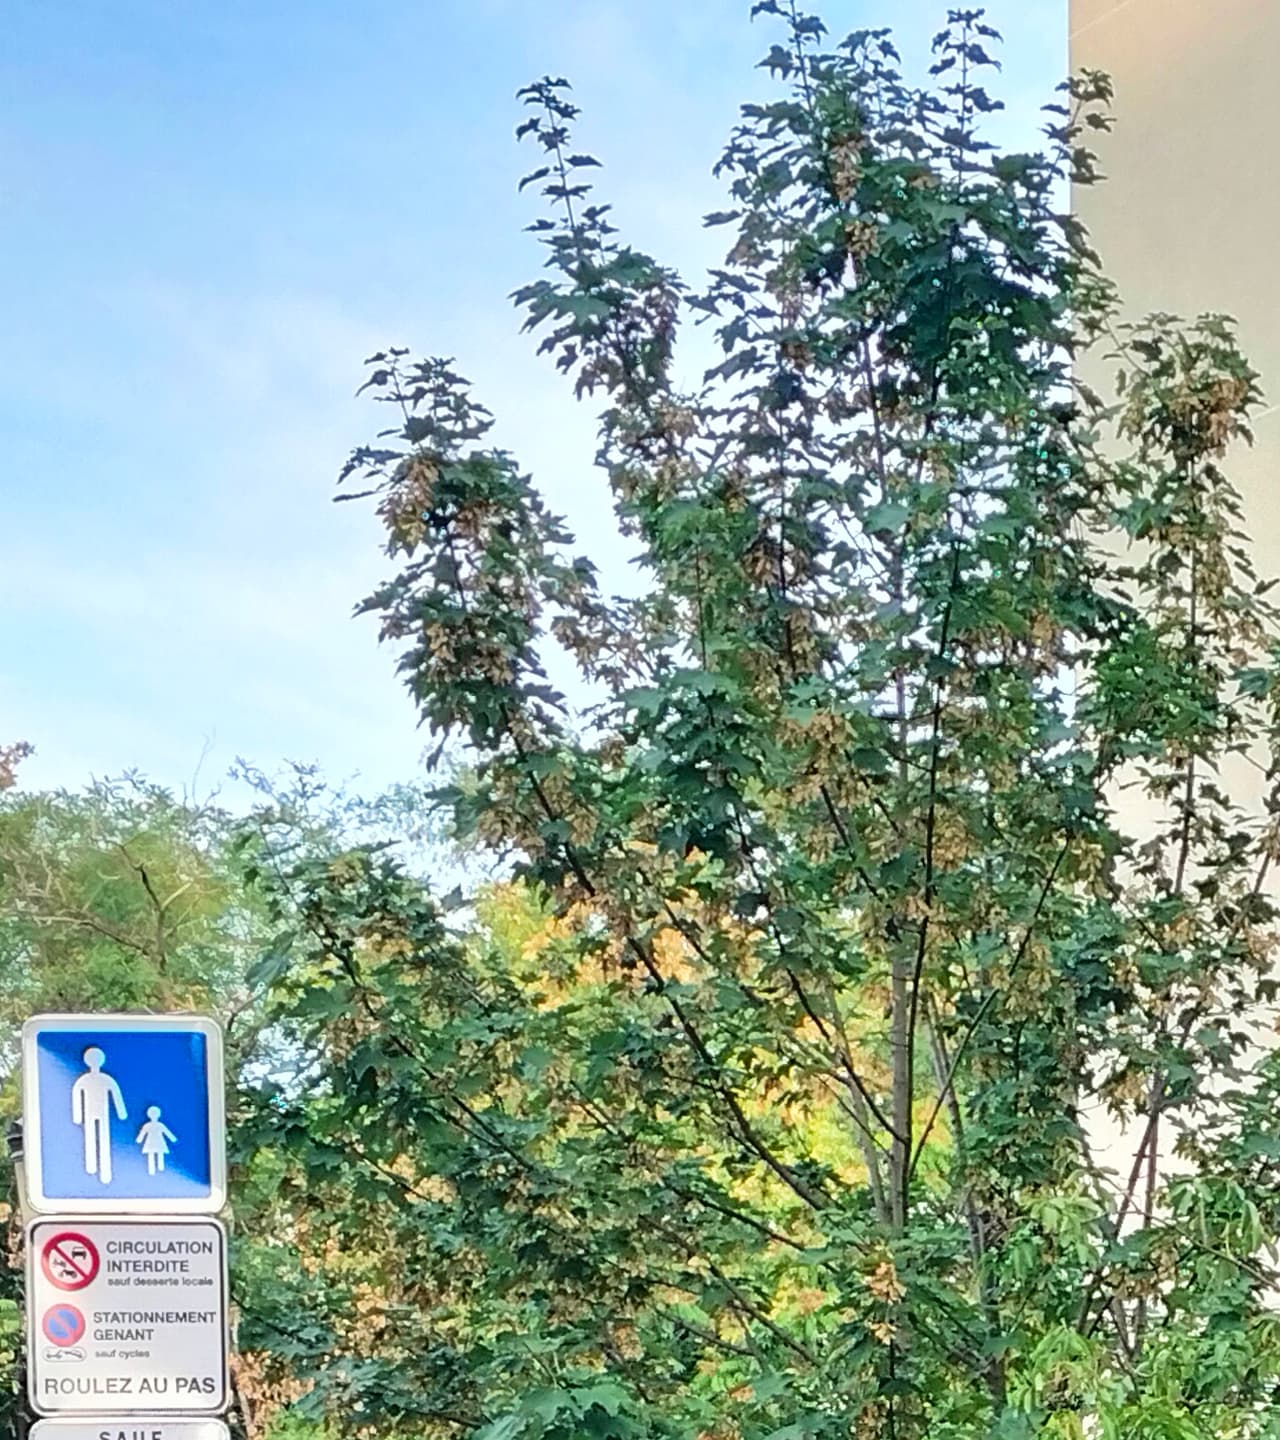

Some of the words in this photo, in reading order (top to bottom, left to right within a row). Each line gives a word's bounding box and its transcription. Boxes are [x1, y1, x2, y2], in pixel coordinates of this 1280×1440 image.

[106, 1241, 213, 1254] CIRCULATION
[107, 1260, 190, 1273] INTERDITE
[108, 1276, 130, 1286] sauf
[134, 1276, 179, 1286] desserte
[182, 1276, 213, 1286] locale
[93, 1311, 216, 1324] STATIONNEMENT
[93, 1329, 155, 1341] GENANT
[95, 1349, 116, 1358] sauf
[119, 1349, 150, 1360] cycles
[44, 1377, 133, 1395] ROULEZ
[139, 1377, 168, 1394] AU
[175, 1377, 216, 1394] PAS
